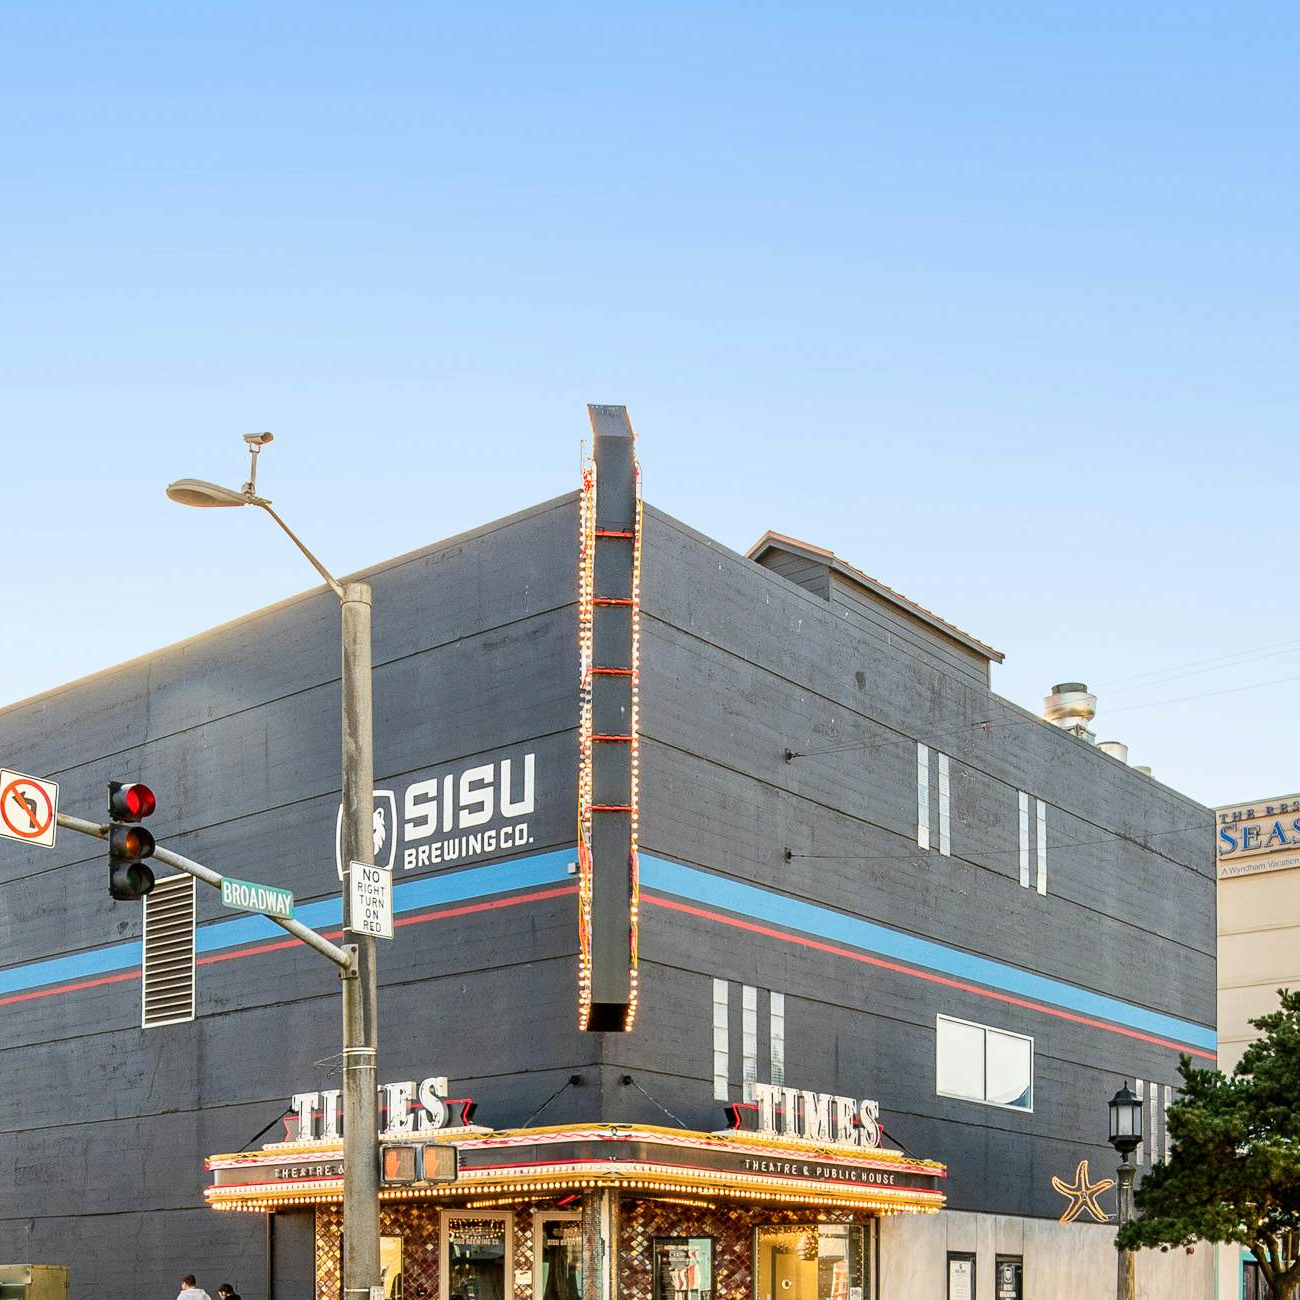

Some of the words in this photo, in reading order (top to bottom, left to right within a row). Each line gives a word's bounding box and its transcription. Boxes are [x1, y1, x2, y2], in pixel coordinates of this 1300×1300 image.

[404, 753, 535, 842] SISU
[1219, 808, 1255, 823] THE
[404, 829, 497, 870] BREWING
[500, 823, 534, 849] CO.
[1221, 867, 1229, 875] A
[1229, 862, 1266, 875] Wyndham
[1267, 857, 1300, 870] Vacation
[362, 869, 380, 883] NO
[357, 881, 385, 896] RIGHT
[222, 881, 292, 915] BROADWAY
[359, 894, 385, 909] TURN
[365, 908, 379, 920] ON
[363, 920, 382, 933] RED
[292, 1076, 448, 1141] TIES
[753, 1083, 880, 1148] TIMES
[274, 1165, 332, 1178] THEATRE
[745, 1159, 798, 1175] THEATRE
[803, 1166, 810, 1176] &
[816, 1167, 856, 1181] PUBLIC
[861, 1172, 895, 1185] HOUSE
